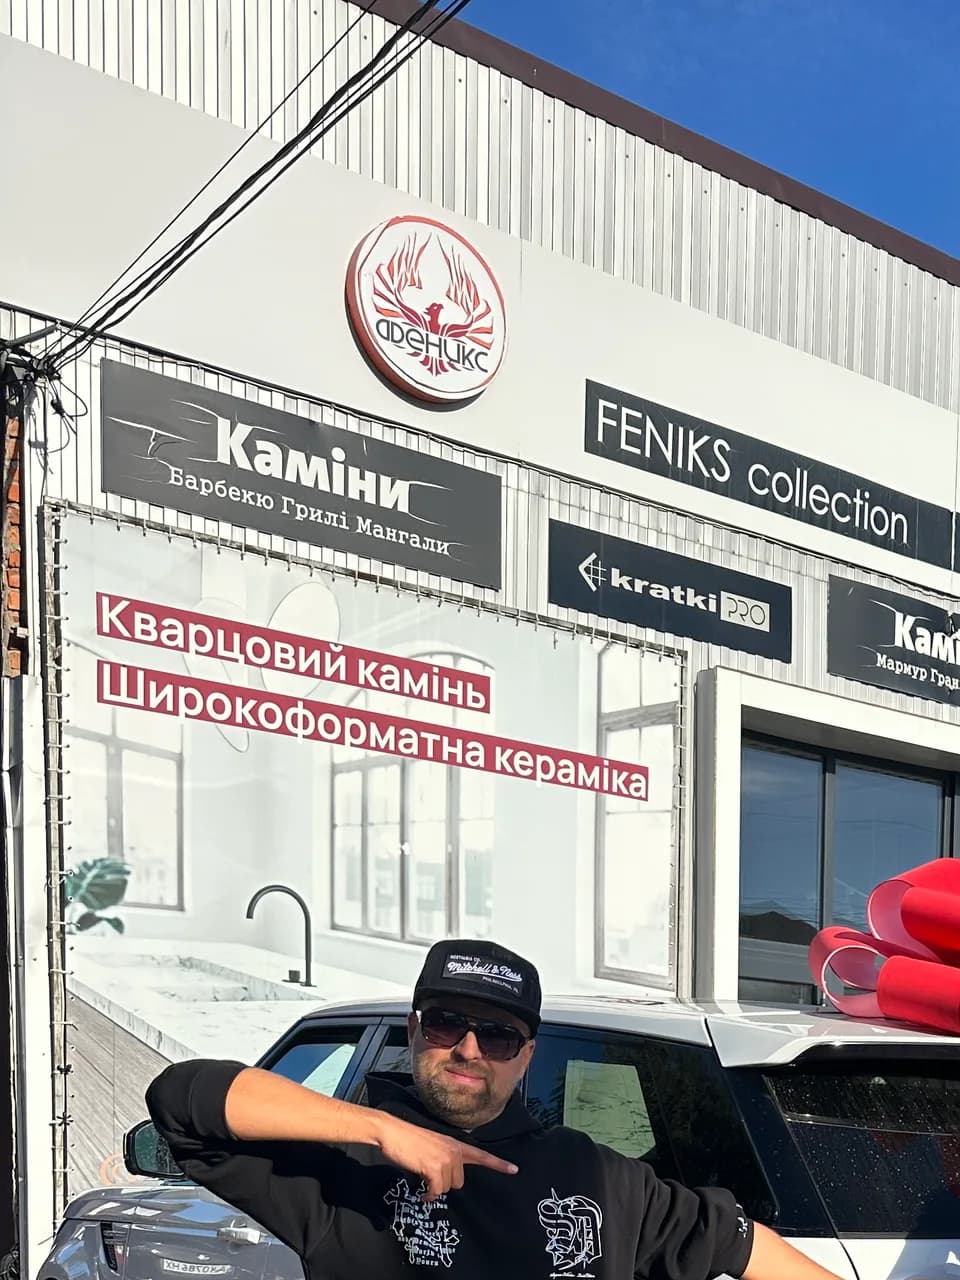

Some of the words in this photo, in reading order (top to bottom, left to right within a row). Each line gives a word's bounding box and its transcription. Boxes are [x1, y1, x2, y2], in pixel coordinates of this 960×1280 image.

[169, 466, 274, 509] Барбекю
[282, 495, 350, 530] Грилі
[356, 515, 451, 556] Мангали
[216, 416, 412, 513] Каміни
[597, 399, 732, 483] FENIKS
[747, 463, 909, 545] collection
[611, 567, 718, 613] kratki
[725, 594, 768, 627] PRO
[101, 597, 347, 682] Кварцовий
[358, 658, 487, 709] камінь
[876, 652, 928, 682] Мармур
[102, 662, 486, 770] Широкоформатна
[495, 746, 648, 800] кераміка
